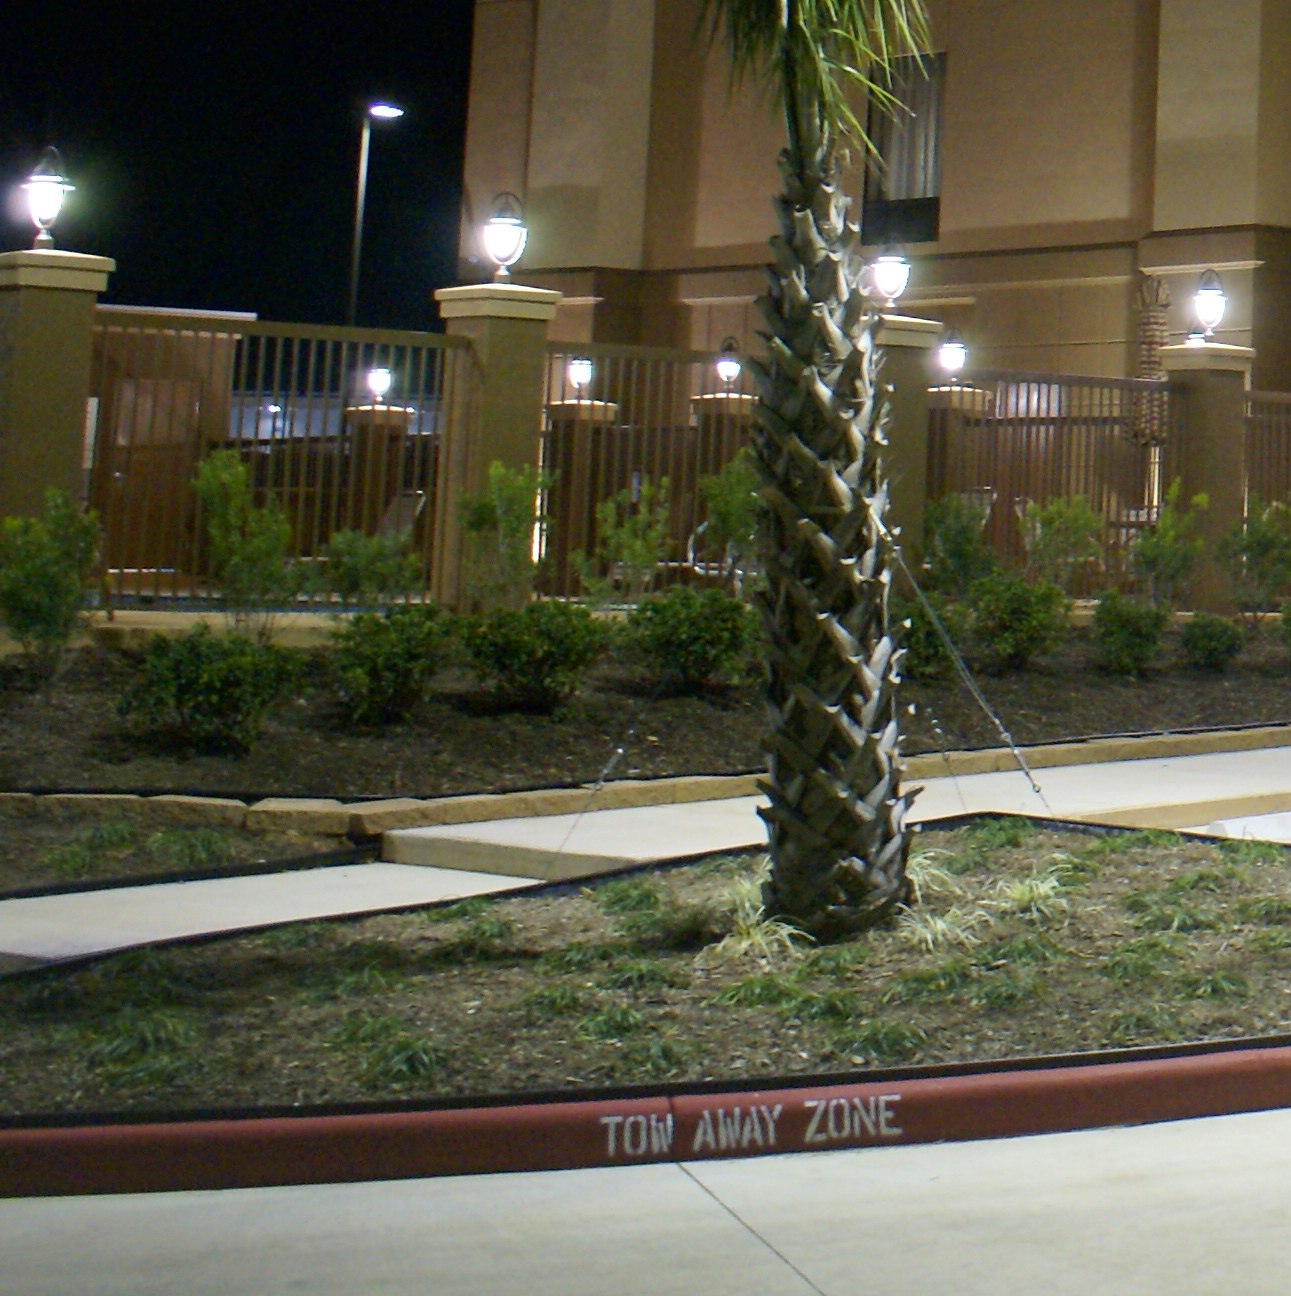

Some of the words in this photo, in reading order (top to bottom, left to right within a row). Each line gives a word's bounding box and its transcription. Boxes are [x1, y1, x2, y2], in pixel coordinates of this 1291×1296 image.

[600, 1112, 674, 1157] TOW
[693, 1103, 784, 1152] AWAY
[803, 1093, 903, 1144] ZONE
